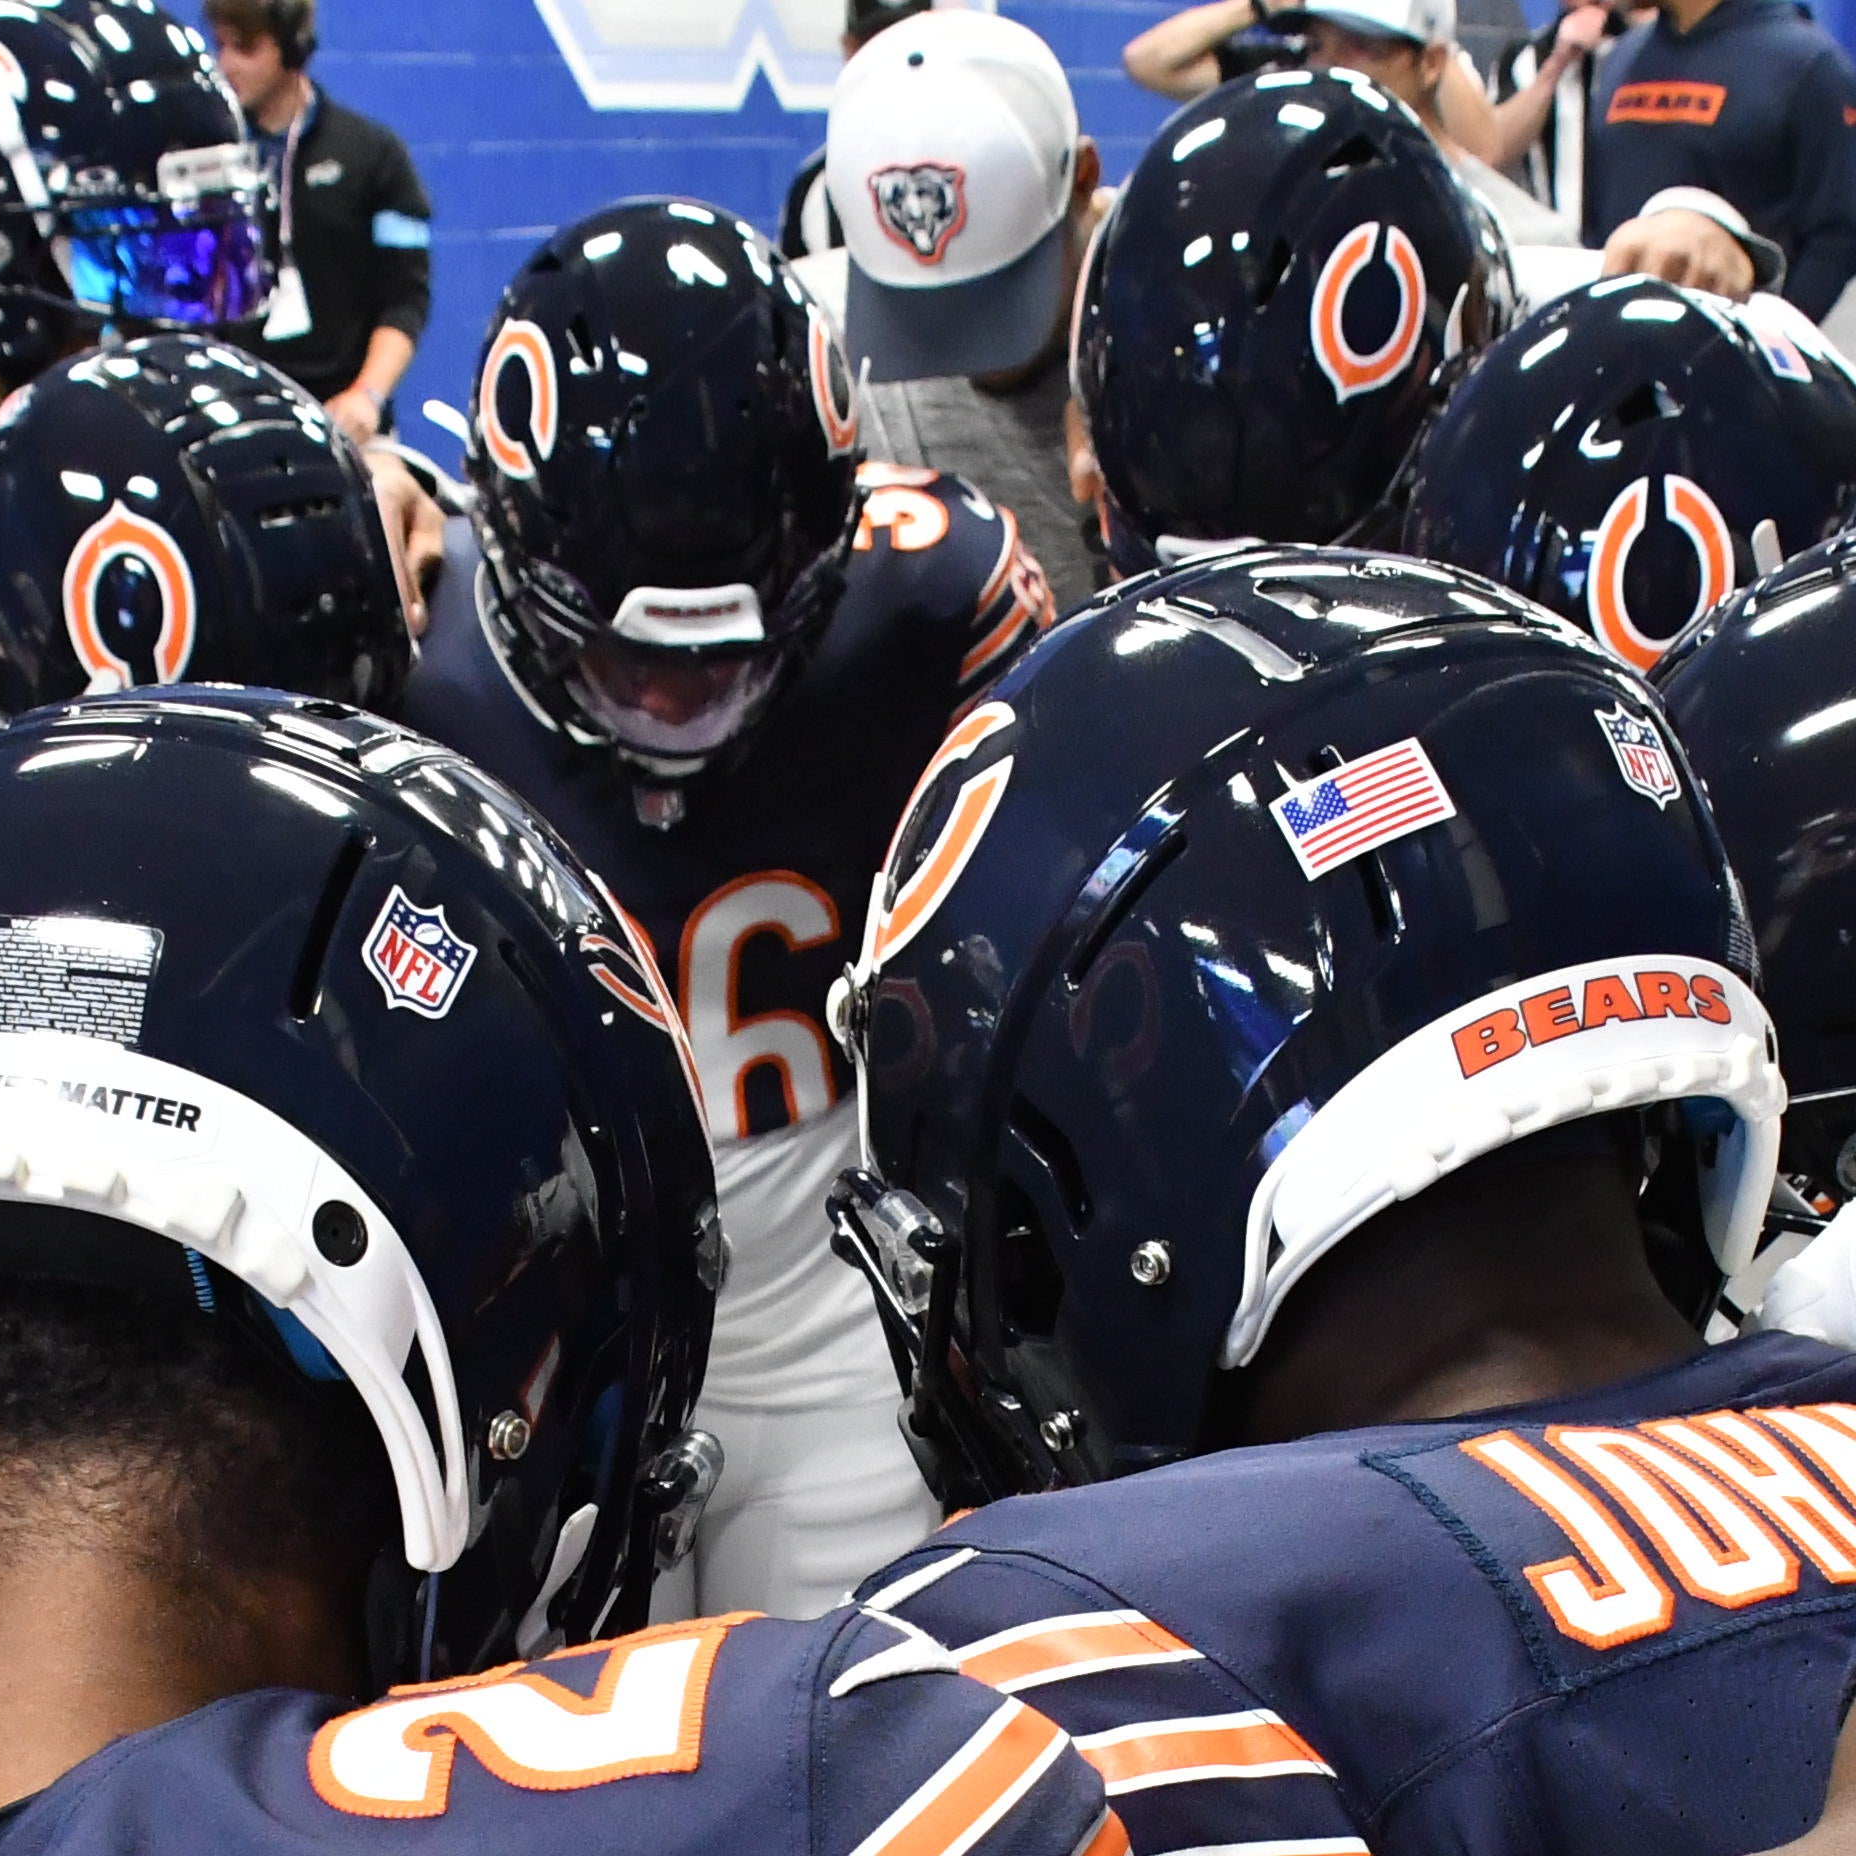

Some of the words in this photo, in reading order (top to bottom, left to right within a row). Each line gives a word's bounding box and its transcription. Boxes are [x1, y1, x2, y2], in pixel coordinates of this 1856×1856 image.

[1622, 746, 1673, 790] NFL
[377, 927, 443, 1004] NFL
[624, 869, 842, 1138] 6
[1450, 971, 1732, 1080] BEARS
[59, 1081, 201, 1133] MATTER
[306, 1611, 769, 1820] 2
